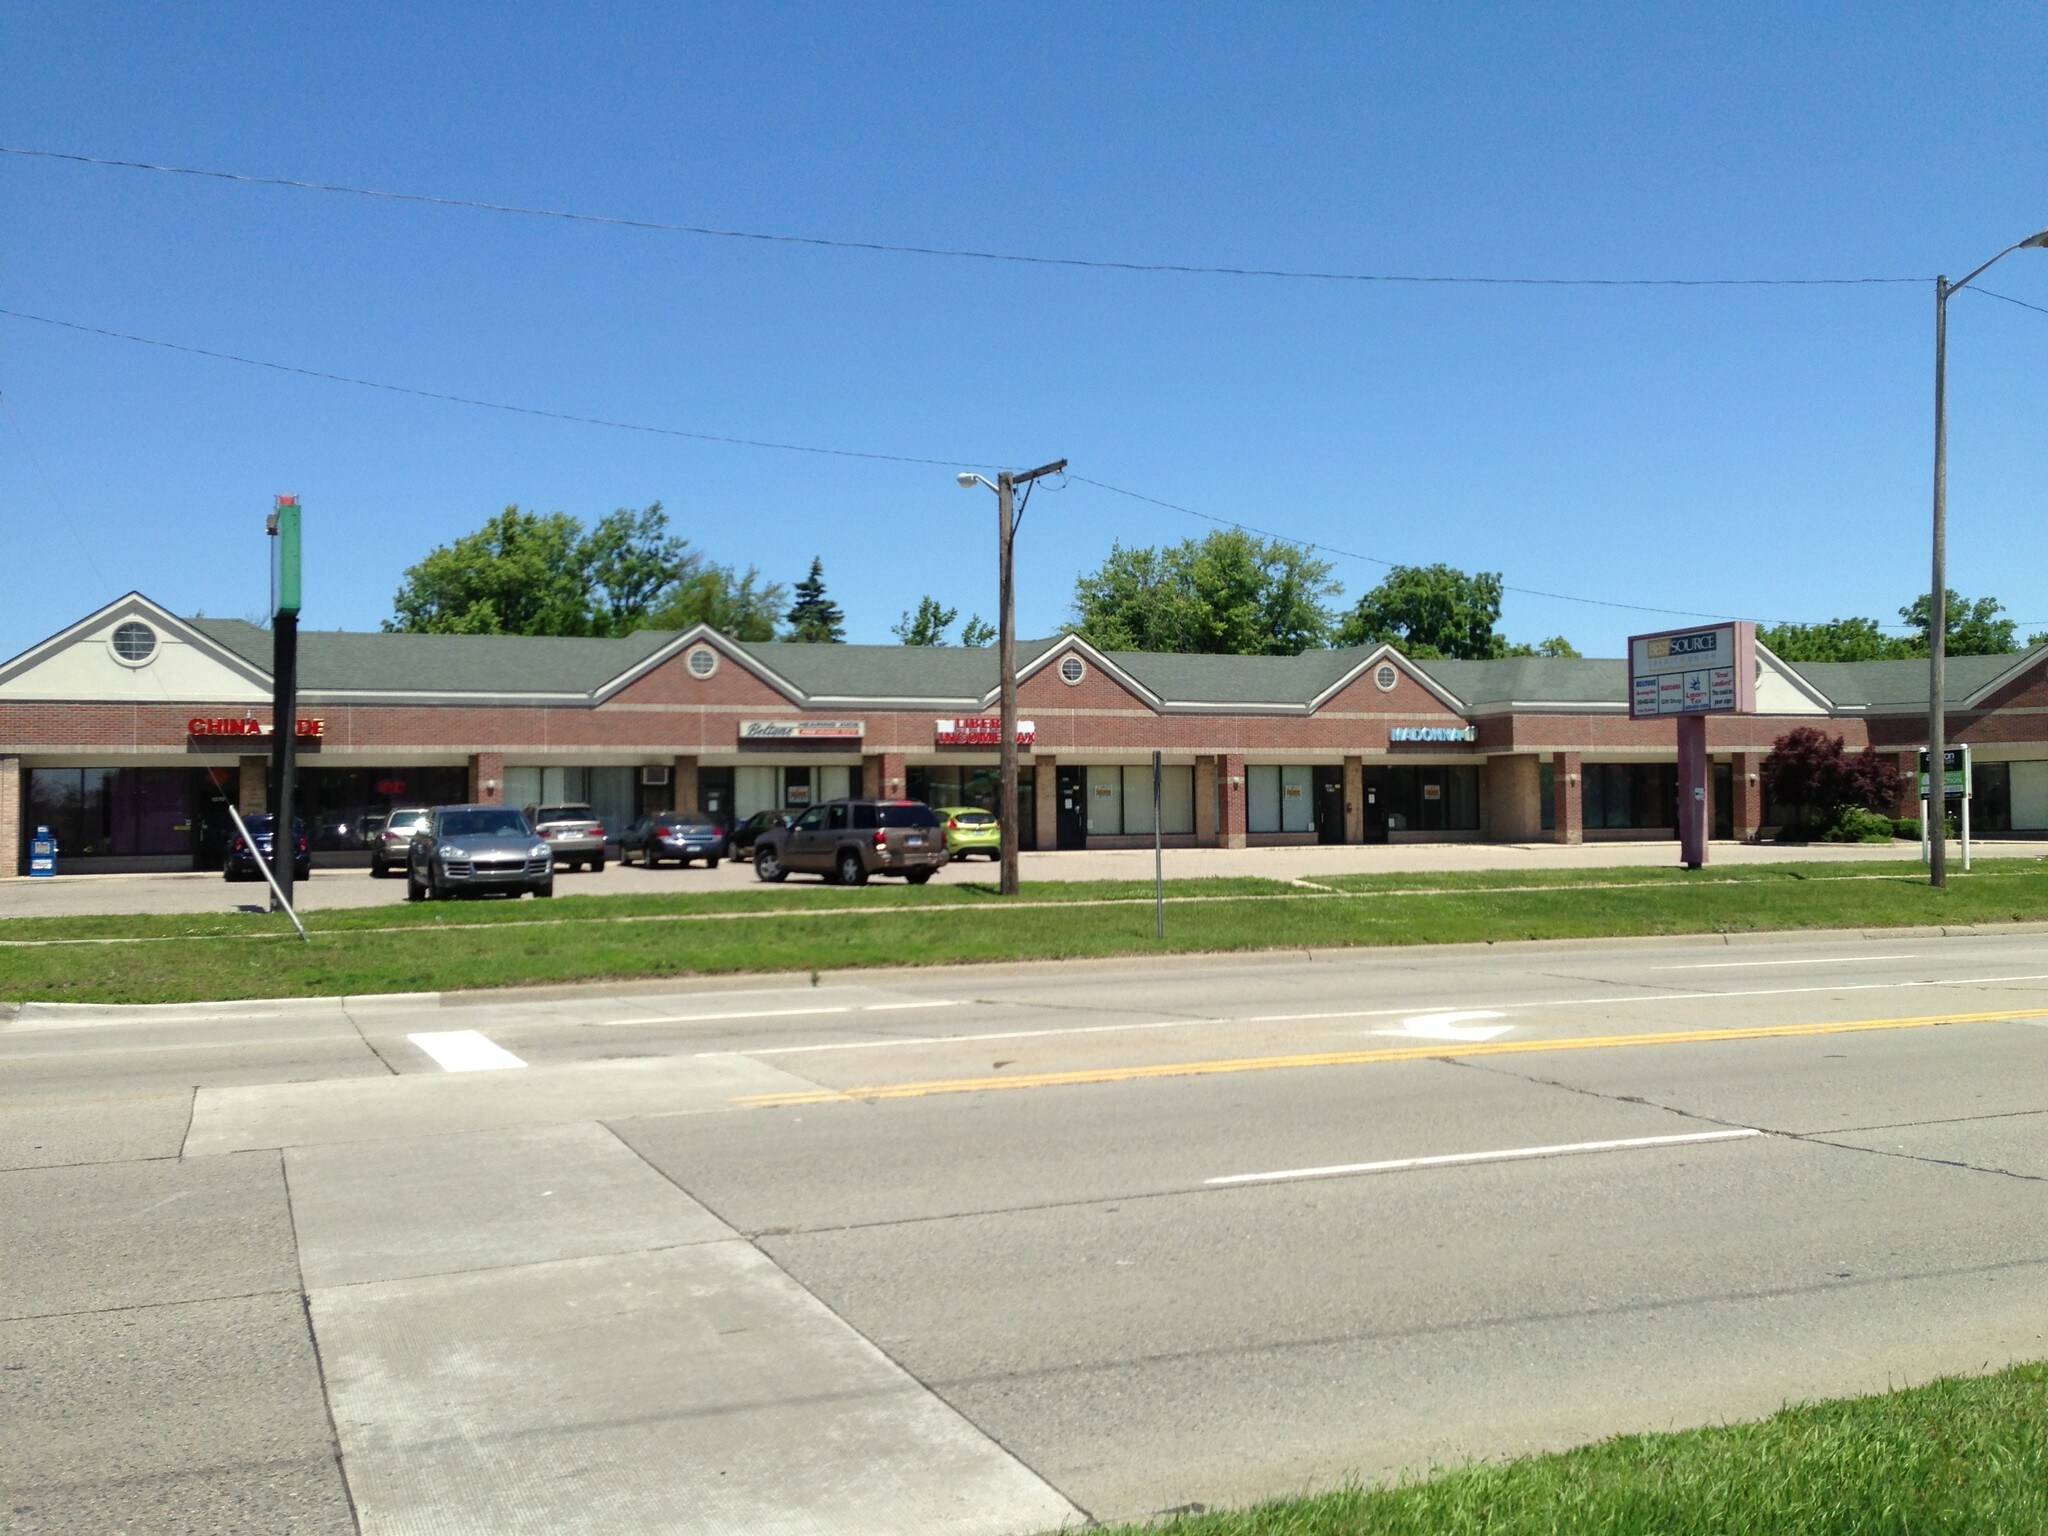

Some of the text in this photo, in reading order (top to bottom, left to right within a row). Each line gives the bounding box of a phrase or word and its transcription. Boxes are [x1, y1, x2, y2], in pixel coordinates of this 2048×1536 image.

[1671, 636, 1715, 653] SOURCE
[187, 719, 262, 735] CHINA
[954, 718, 1002, 729] LIBER
[938, 732, 1036, 744] INCOME AX
[1391, 727, 1464, 741] MADONNA
